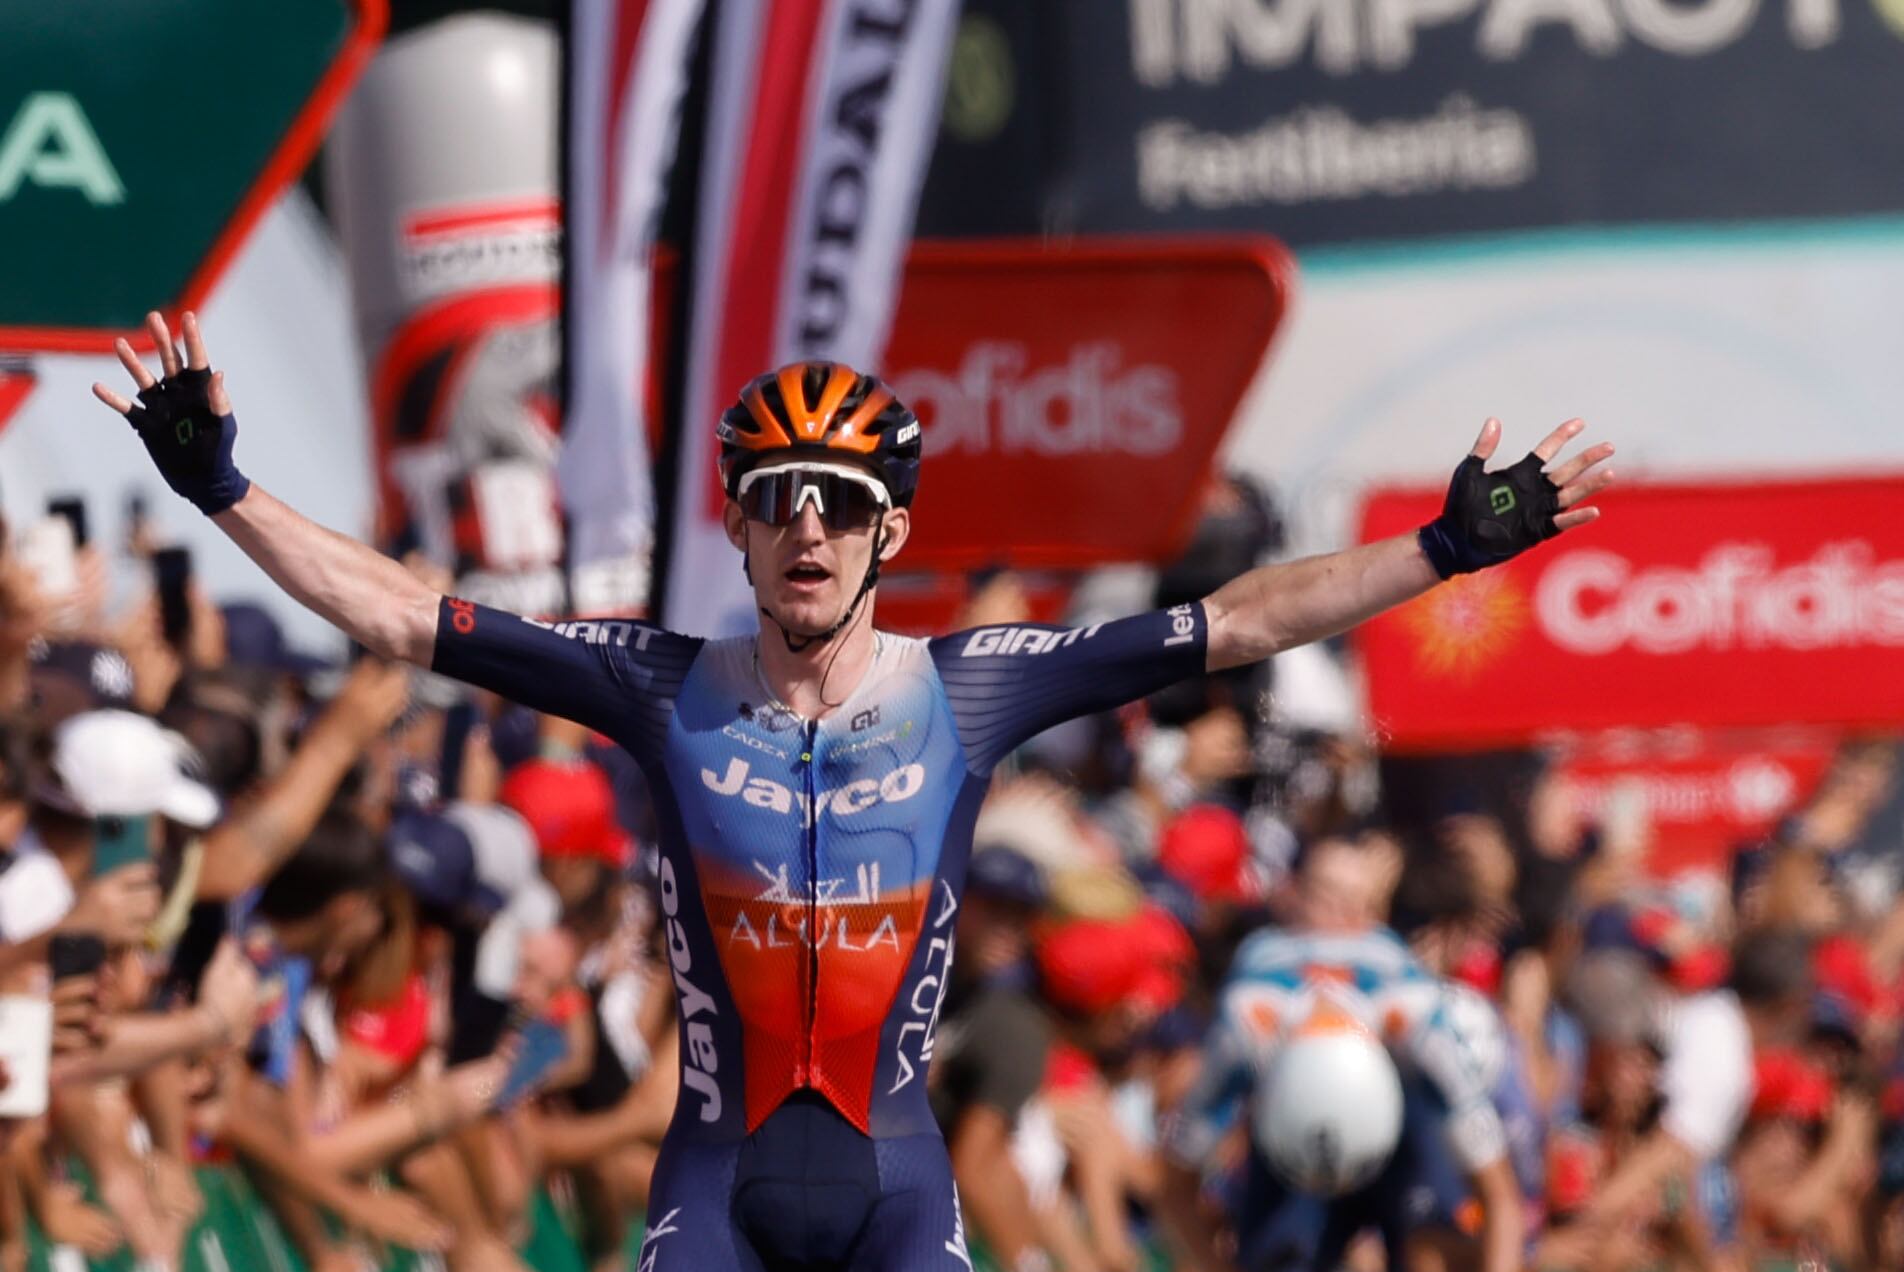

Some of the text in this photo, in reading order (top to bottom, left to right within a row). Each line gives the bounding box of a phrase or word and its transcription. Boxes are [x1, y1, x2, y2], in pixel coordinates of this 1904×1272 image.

[890, 342, 1184, 457] ofidis
[701, 756, 925, 830] Jayco
[661, 856, 722, 1123] Jayco
